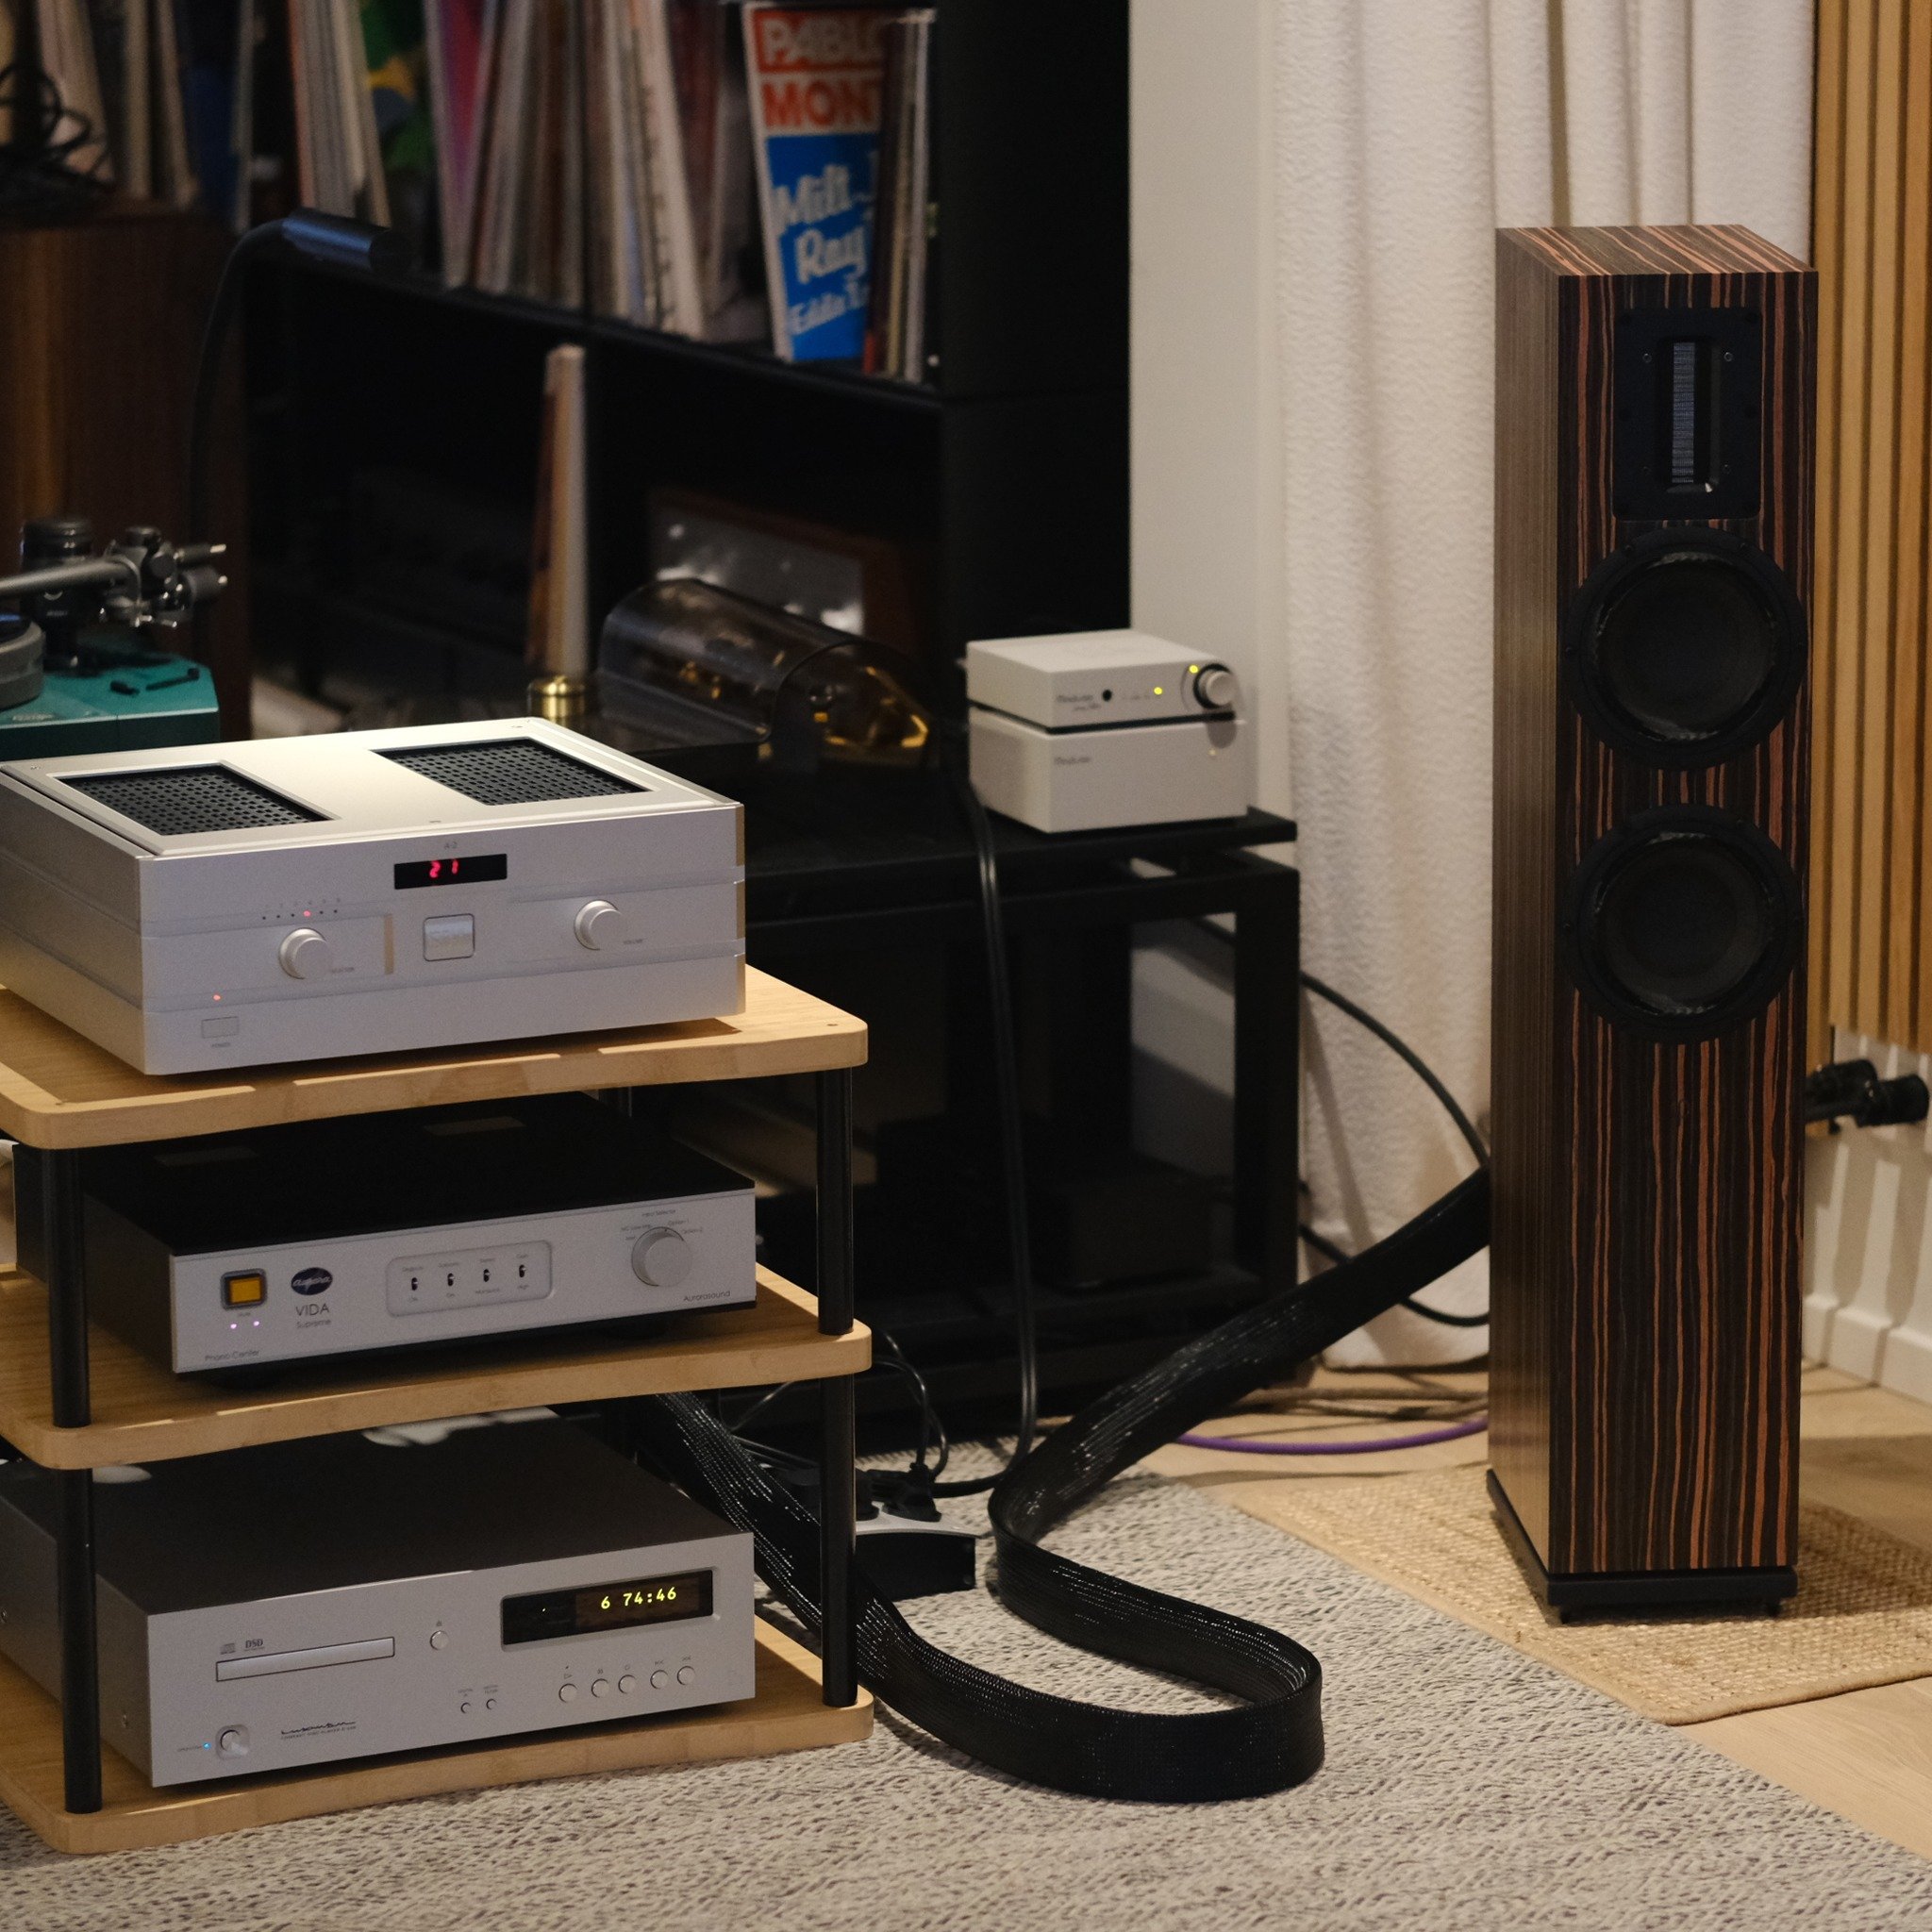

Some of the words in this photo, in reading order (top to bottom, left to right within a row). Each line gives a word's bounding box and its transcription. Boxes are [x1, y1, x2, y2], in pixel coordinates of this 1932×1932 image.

[794, 225, 867, 286] Ray
[428, 858, 459, 878] 21
[683, 1290, 731, 1302] Aurorasound
[295, 1303, 330, 1316] VIDA
[600, 1595, 611, 1609] 6
[623, 1587, 677, 1607] 74:46
[244, 1638, 264, 1648] DSD
